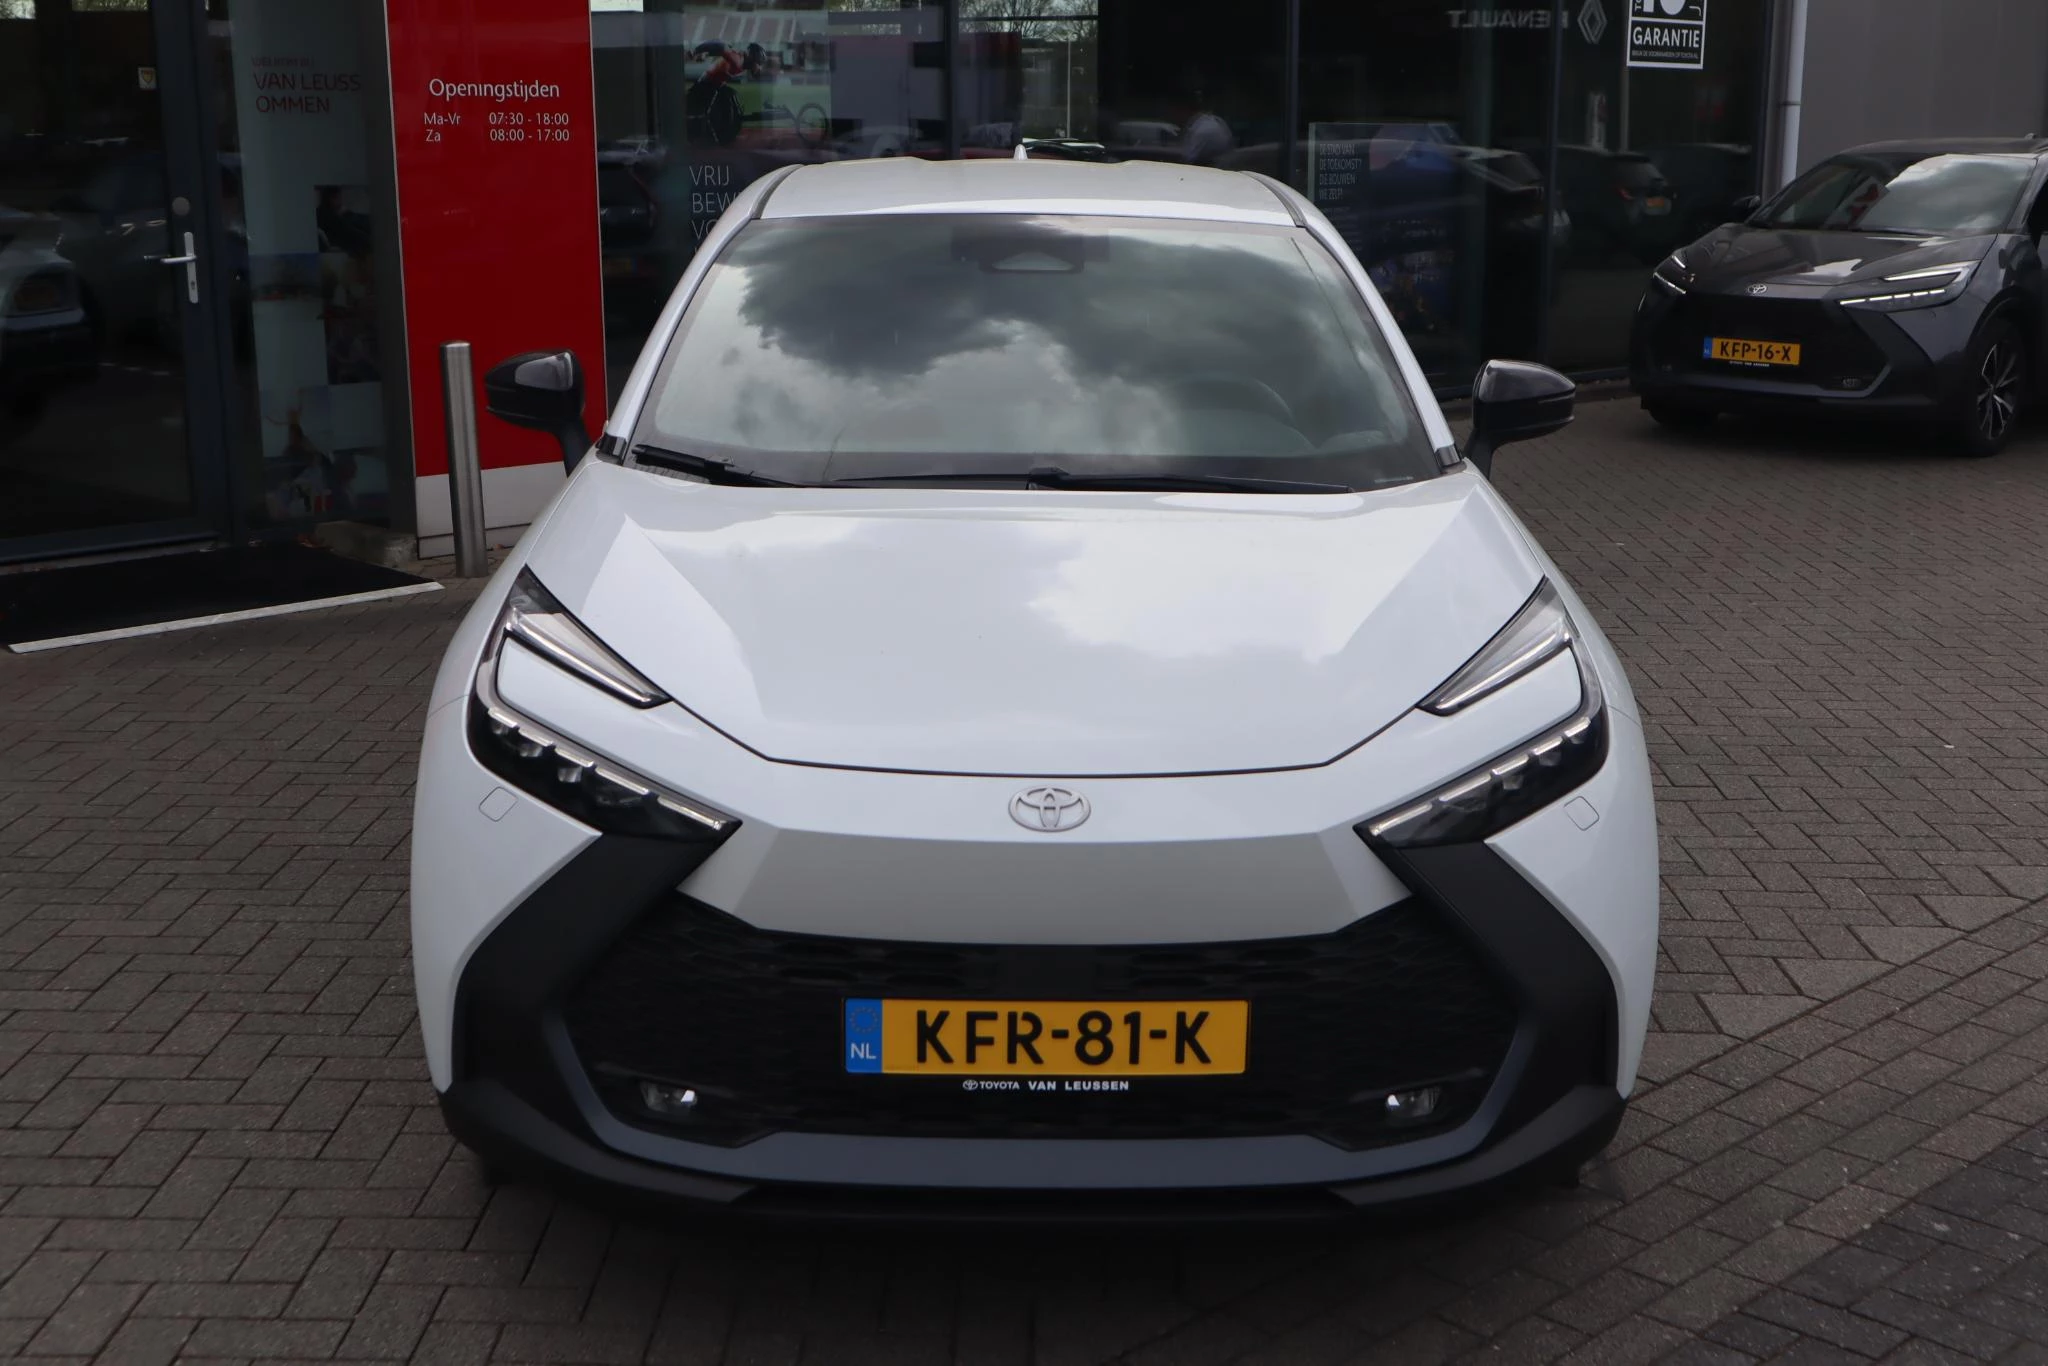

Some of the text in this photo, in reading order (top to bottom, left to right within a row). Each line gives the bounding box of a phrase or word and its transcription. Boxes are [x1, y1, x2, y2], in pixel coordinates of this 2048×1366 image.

[1632, 26, 1700, 48] GARANTIE
[254, 73, 362, 92] VAN LEUSS
[428, 78, 560, 102] Openingstijden
[256, 95, 331, 114] OMMEN
[423, 112, 461, 125] Ma-Vr
[488, 112, 524, 125] 07:30
[536, 112, 569, 125] 18:00
[425, 129, 441, 142] Za
[489, 128, 525, 142] 08:00
[537, 129, 570, 142] 17:00
[688, 164, 731, 187] VRIJ
[692, 191, 741, 213] BEW
[1720, 341, 1791, 361] KFP-16-X
[850, 1010, 1212, 1066] NL KFR-81-K
[979, 1081, 1129, 1091] TOYOTA VAN LEUSSEN
